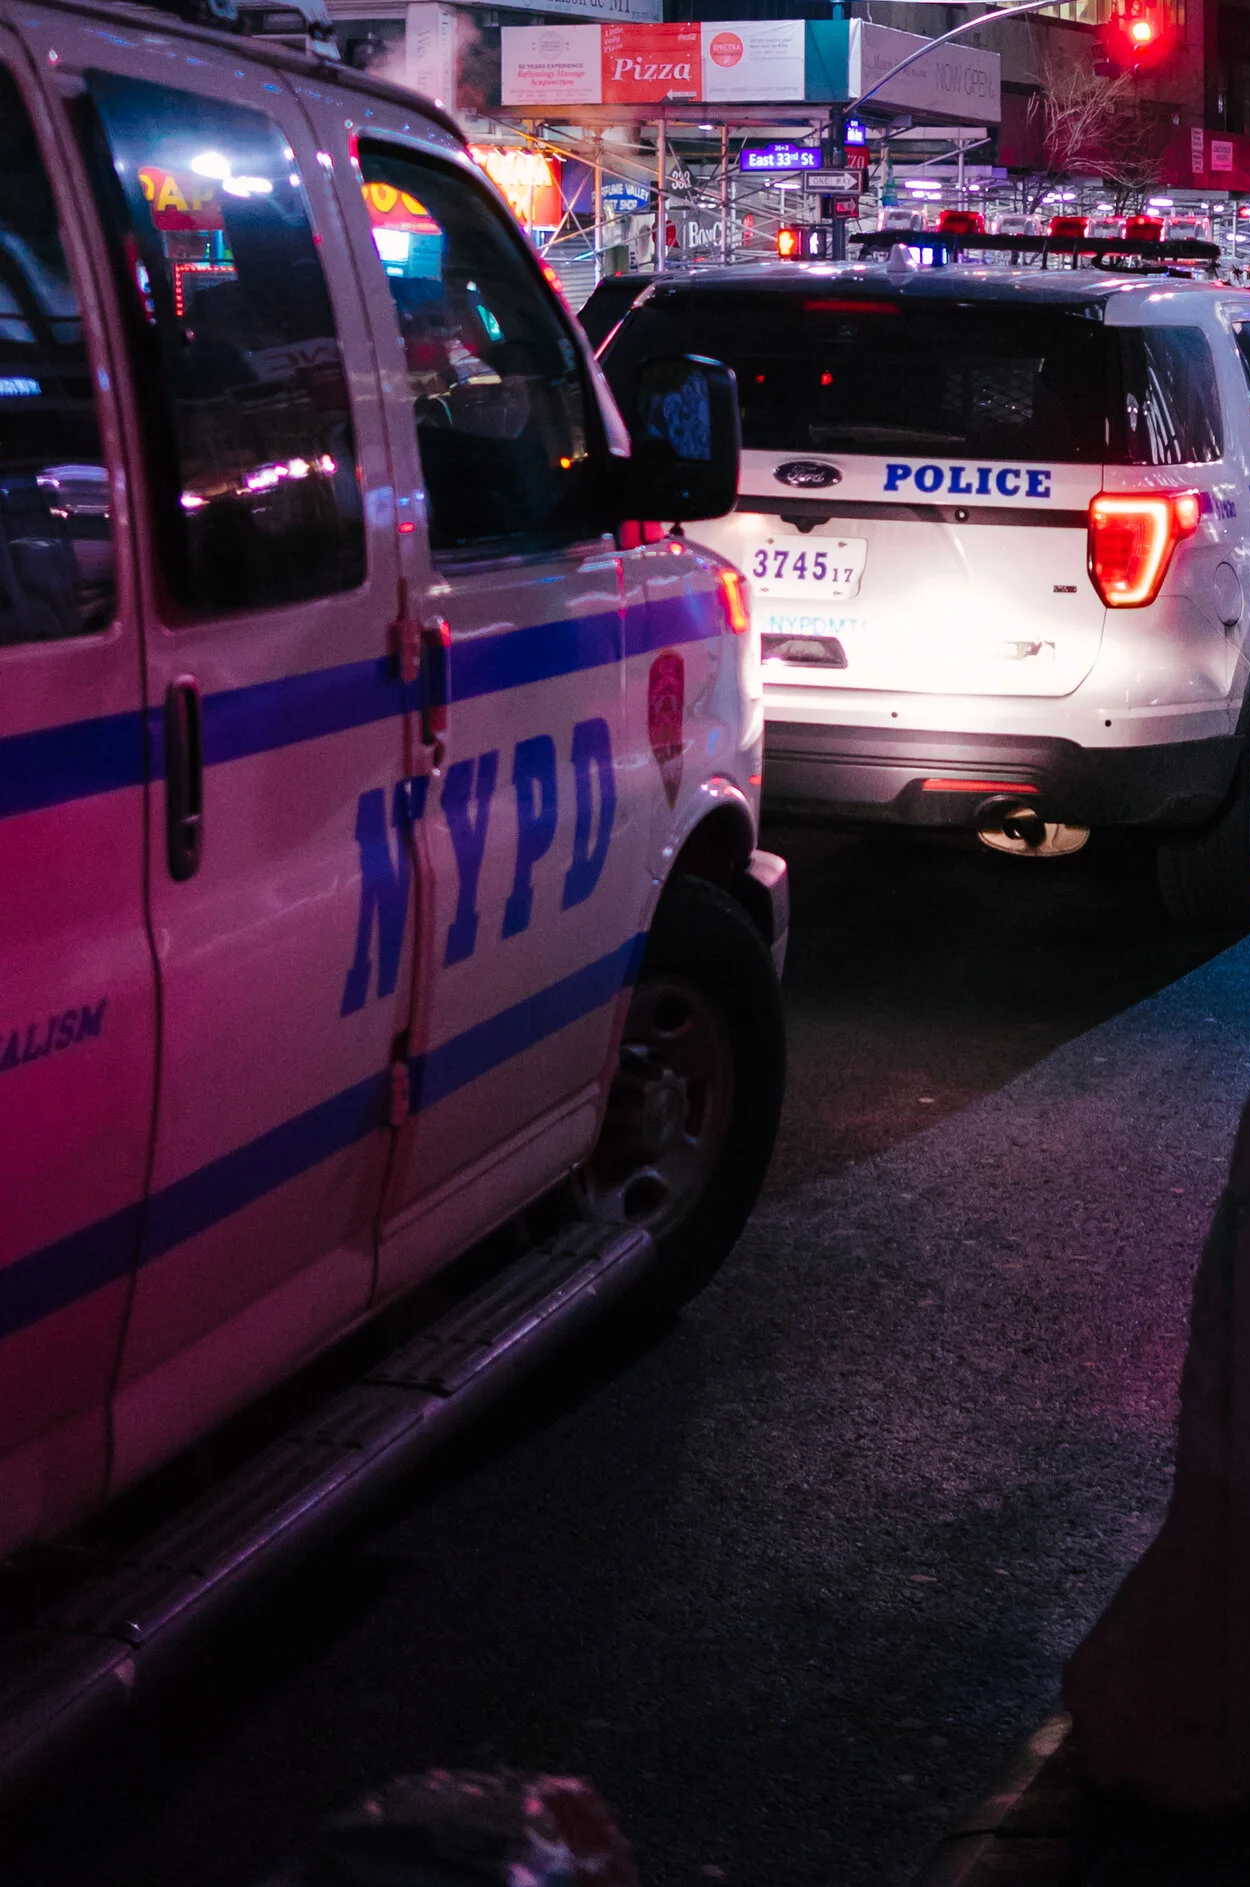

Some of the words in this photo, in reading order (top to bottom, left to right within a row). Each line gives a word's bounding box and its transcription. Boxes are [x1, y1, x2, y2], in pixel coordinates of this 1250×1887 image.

[611, 56, 692, 81] Pizza
[935, 62, 962, 93] NOW
[749, 153, 775, 167] East
[776, 152, 799, 167] 33rd
[801, 152, 815, 166] St
[812, 177, 829, 185] ONE
[592, 183, 624, 202] PRFUME
[625, 183, 650, 202] VALLEY
[619, 199, 638, 210] SHOP
[786, 465, 825, 485] Ford
[883, 463, 1052, 499] POLICE
[752, 549, 828, 581] 3745
[832, 568, 854, 583] 17
[340, 717, 616, 1018] NYPD
